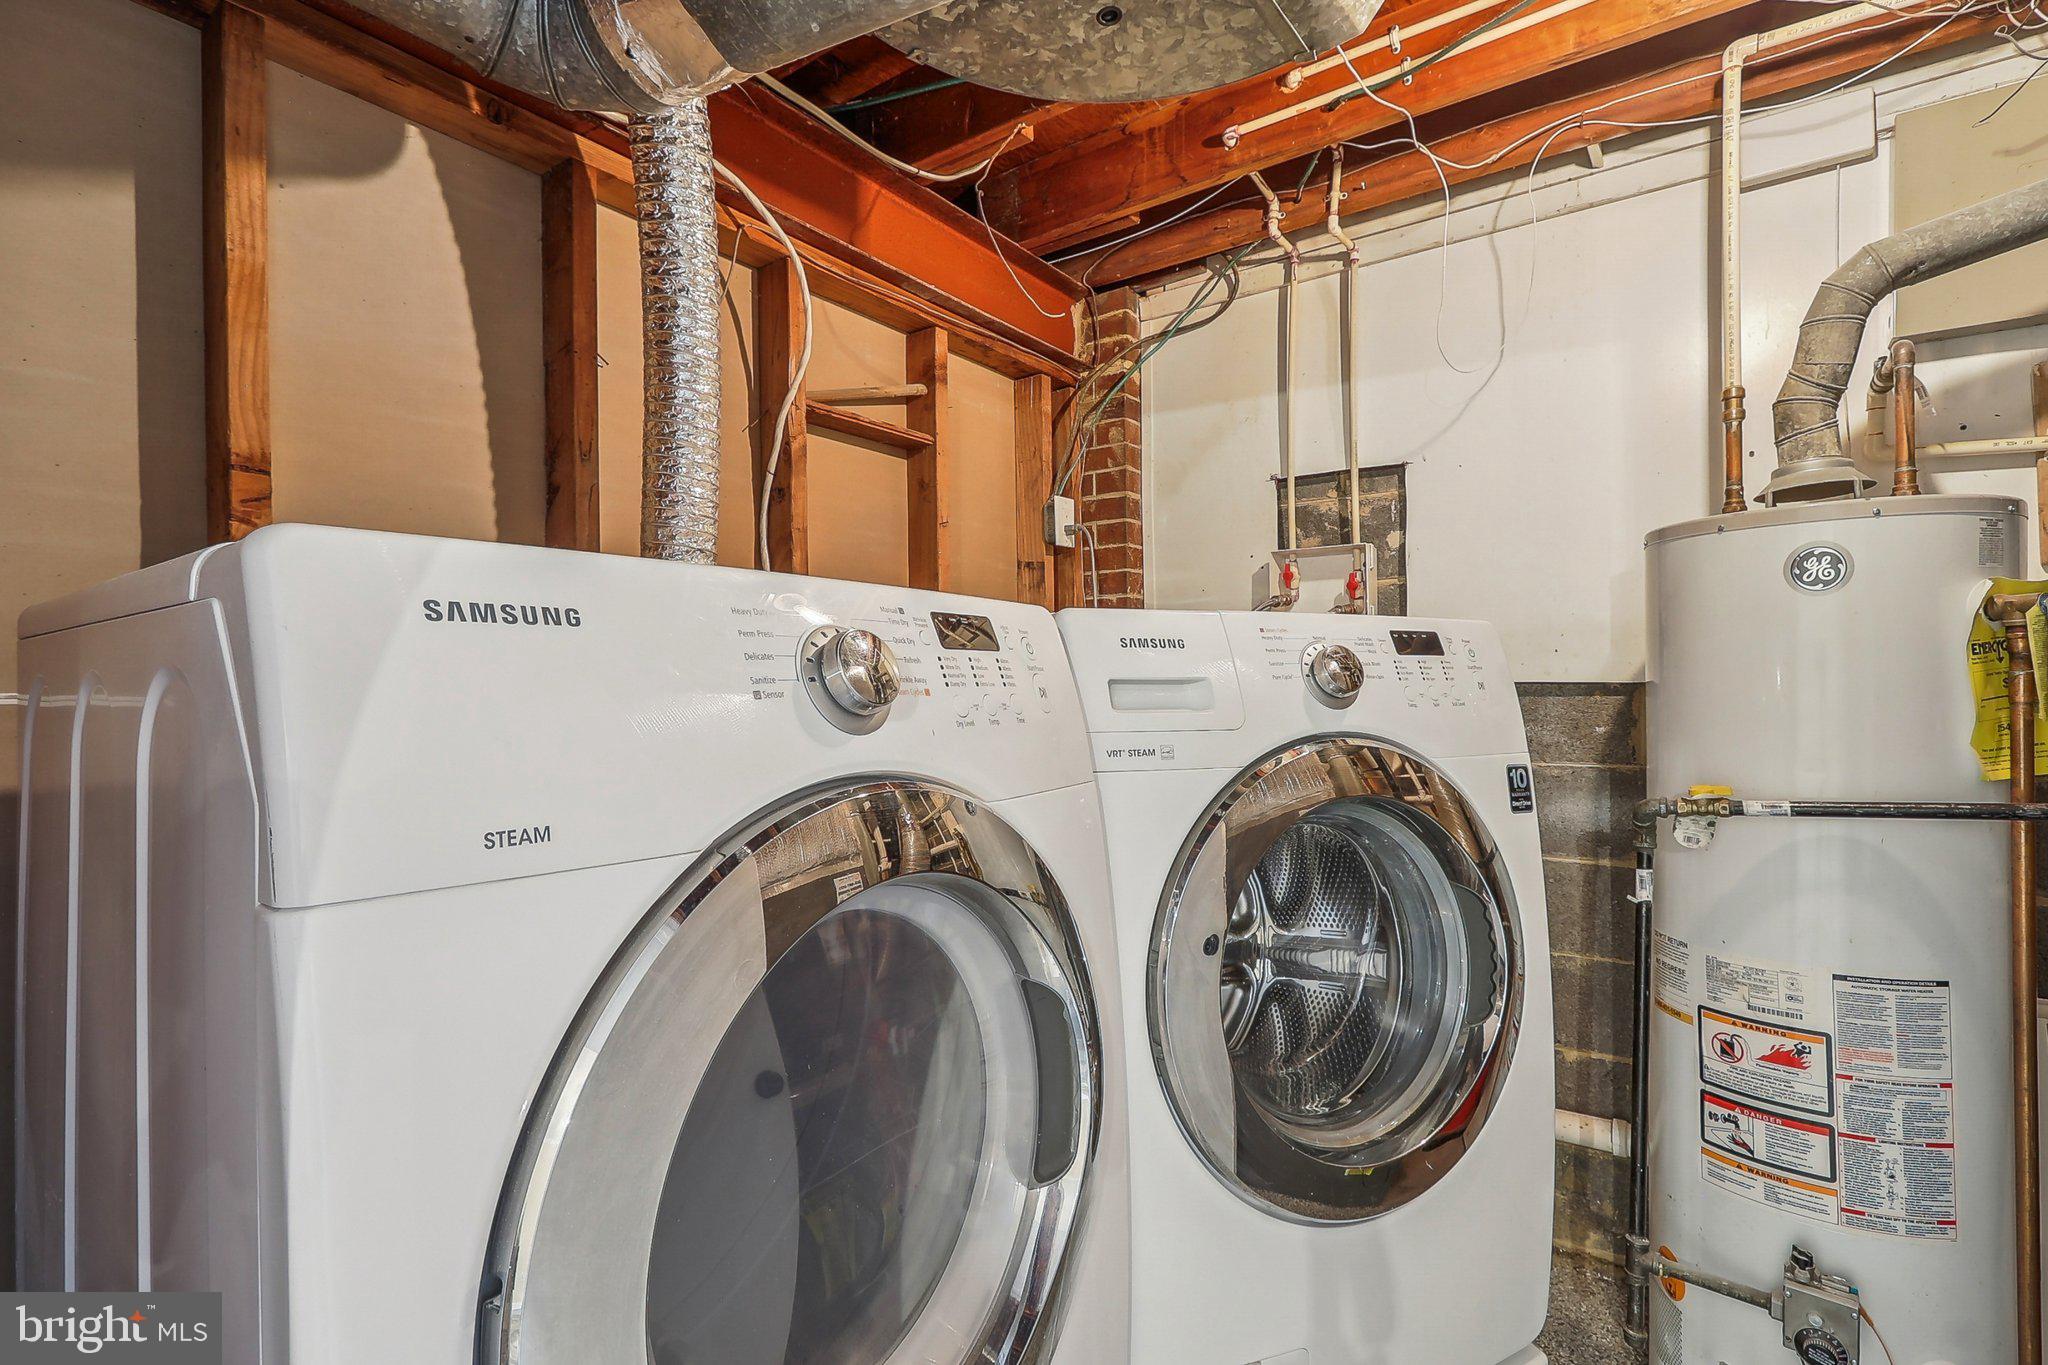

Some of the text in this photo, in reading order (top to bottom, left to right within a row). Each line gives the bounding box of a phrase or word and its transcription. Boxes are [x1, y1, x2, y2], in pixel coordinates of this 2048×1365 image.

[422, 599, 581, 627] SAMSUNG
[892, 637, 915, 646] Quick Dry
[1120, 637, 1185, 649] SAMSUNG
[744, 652, 775, 661] Delicates
[749, 676, 776, 684] Sanitize
[762, 691, 785, 699] Sensor
[956, 721, 965, 729] Dry
[1127, 749, 1156, 757] STEAM
[1510, 768, 1527, 788] 10
[484, 825, 551, 850] STEAM
[1667, 936, 1688, 949] RETURN
[1741, 1022, 1787, 1037] WARNING
[1744, 1110, 1782, 1125] DANGER
[1747, 1166, 1789, 1185] WARNING
